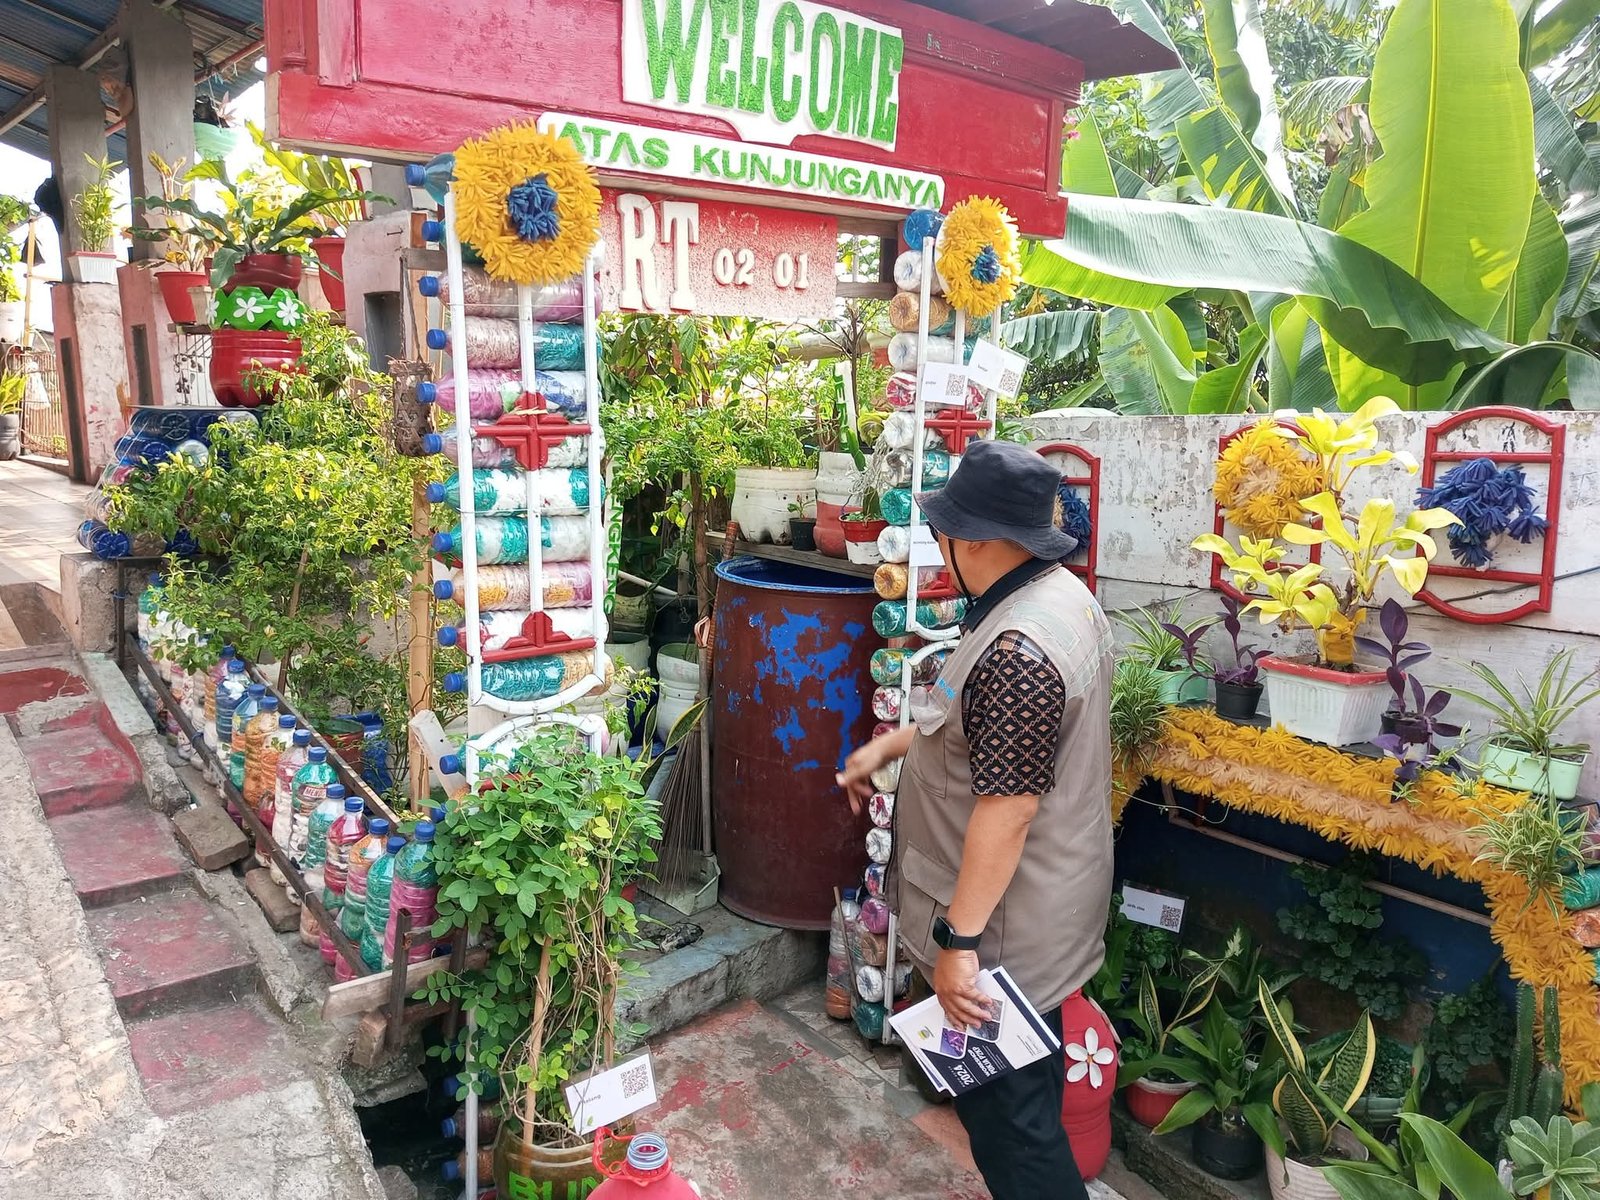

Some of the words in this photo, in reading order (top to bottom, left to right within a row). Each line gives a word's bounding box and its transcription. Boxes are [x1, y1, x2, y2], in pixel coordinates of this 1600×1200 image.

[641, 0, 903, 146] WELCOME
[557, 121, 669, 169] ATAS
[693, 143, 942, 210] KUNJUNGANYA
[616, 193, 700, 313] RT
[713, 248, 754, 288] 02
[772, 251, 810, 290] 01
[953, 1064, 975, 1086] 2024
